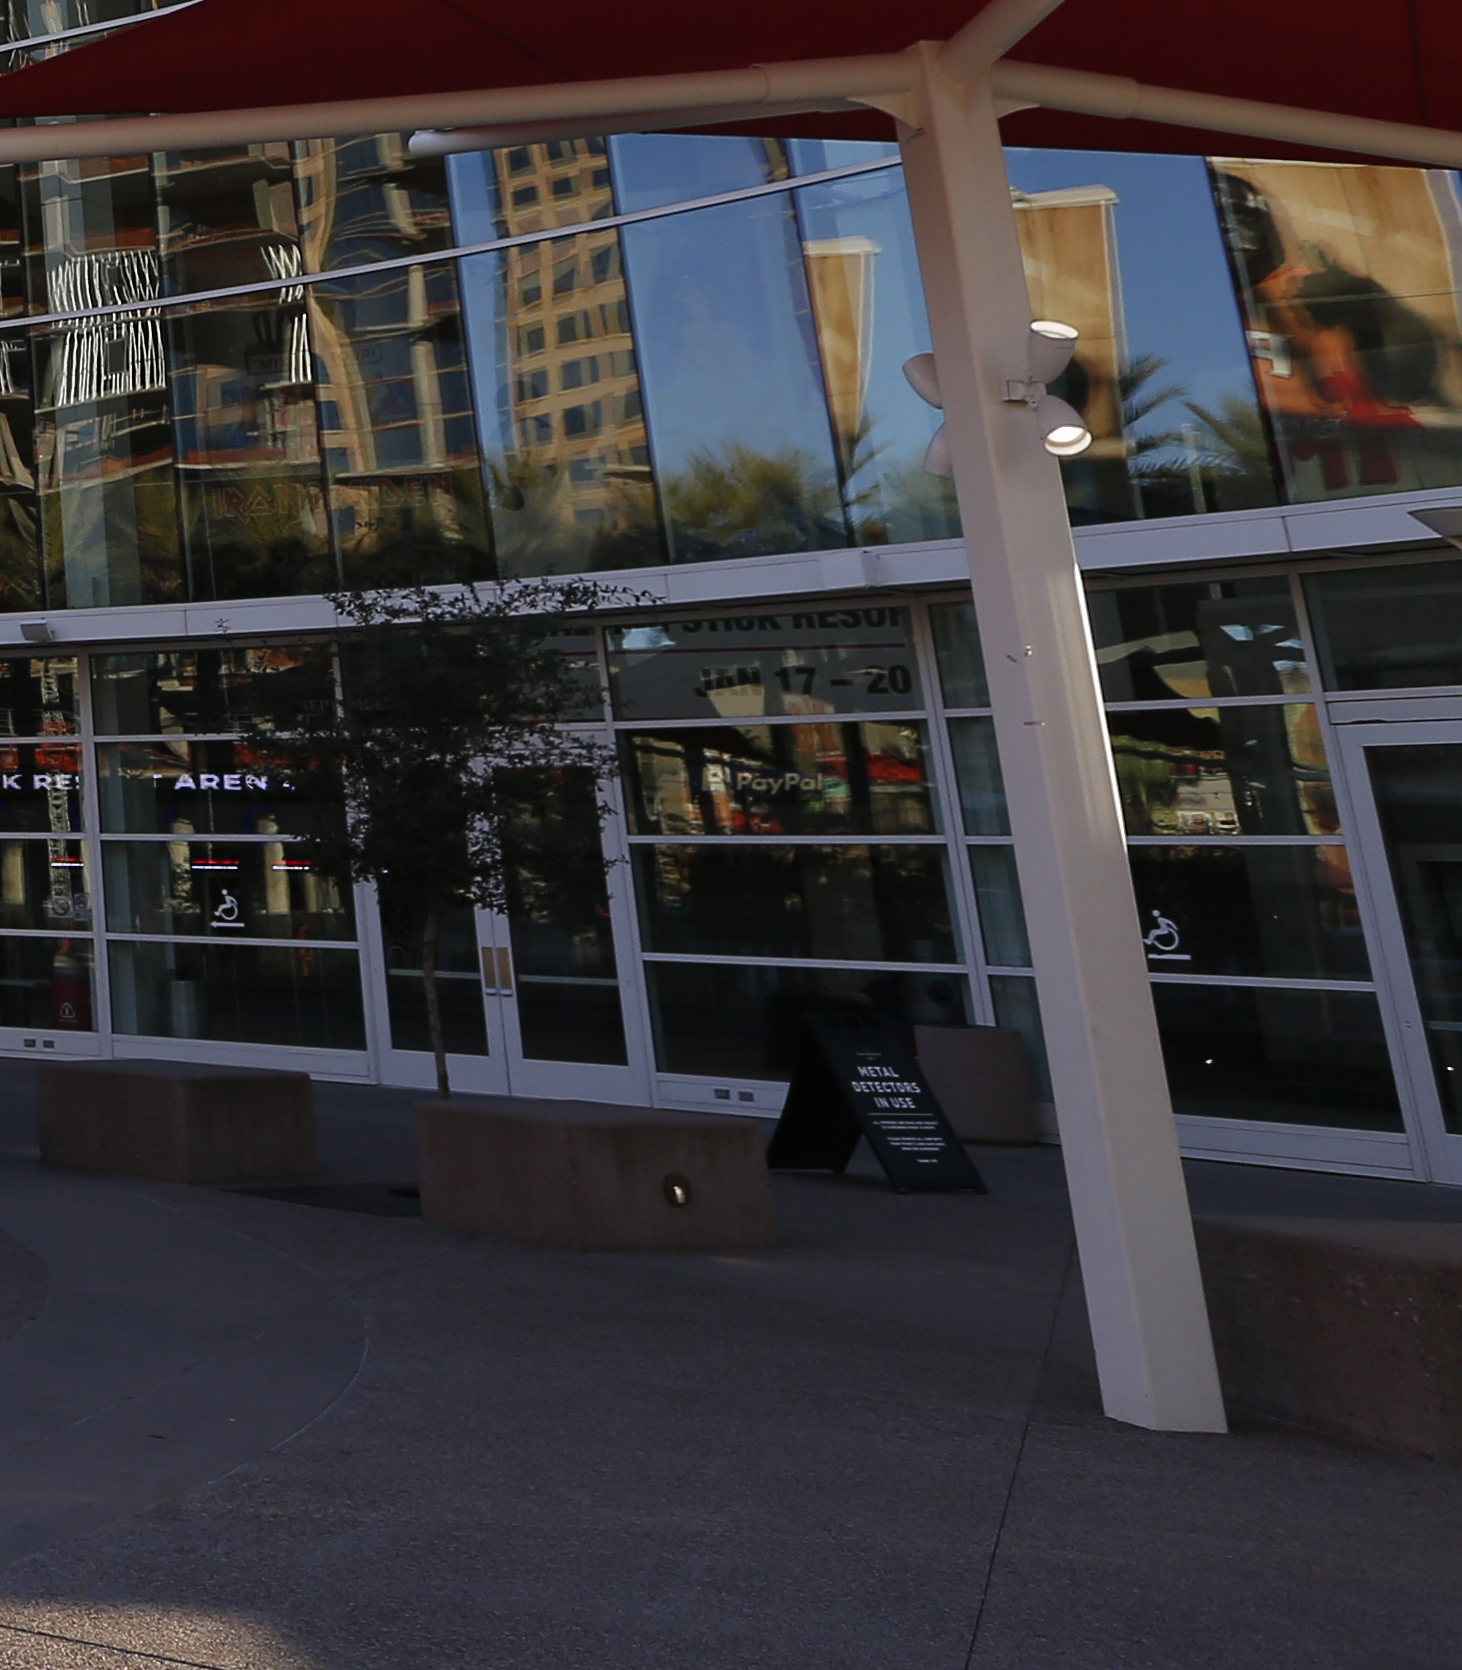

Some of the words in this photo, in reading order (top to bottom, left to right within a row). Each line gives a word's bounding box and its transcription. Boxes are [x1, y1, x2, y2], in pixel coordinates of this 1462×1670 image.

[694, 666, 762, 698] JAN
[774, 666, 817, 697] 17
[868, 665, 912, 695] 20
[173, 773, 296, 791] AREN
[736, 773, 823, 793] PayPal
[857, 1065, 900, 1078] METAL
[851, 1081, 922, 1093] DETECTORS
[873, 1097, 890, 1108] IN
[891, 1097, 916, 1109] USE
